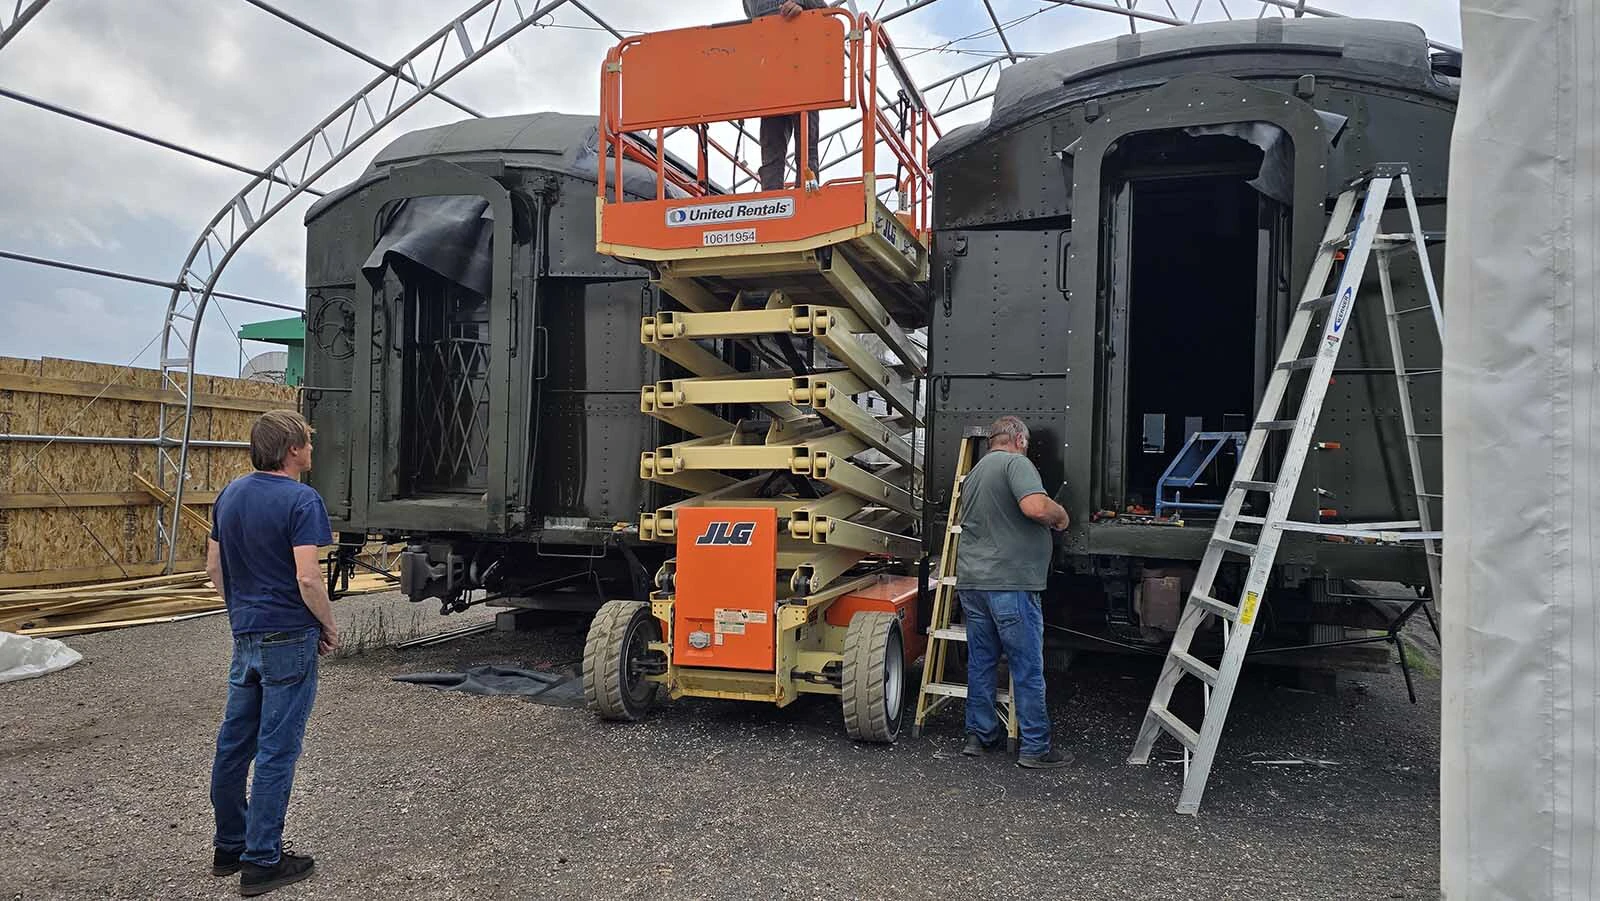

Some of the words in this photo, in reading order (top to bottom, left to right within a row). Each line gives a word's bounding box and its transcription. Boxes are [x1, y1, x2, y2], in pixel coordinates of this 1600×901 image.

[689, 206, 734, 221] United
[736, 202, 787, 217] Rentals
[704, 231, 755, 244] 10611954
[882, 219, 896, 245] JLG
[1337, 295, 1349, 323] WERNER
[696, 522, 756, 545] JLG
